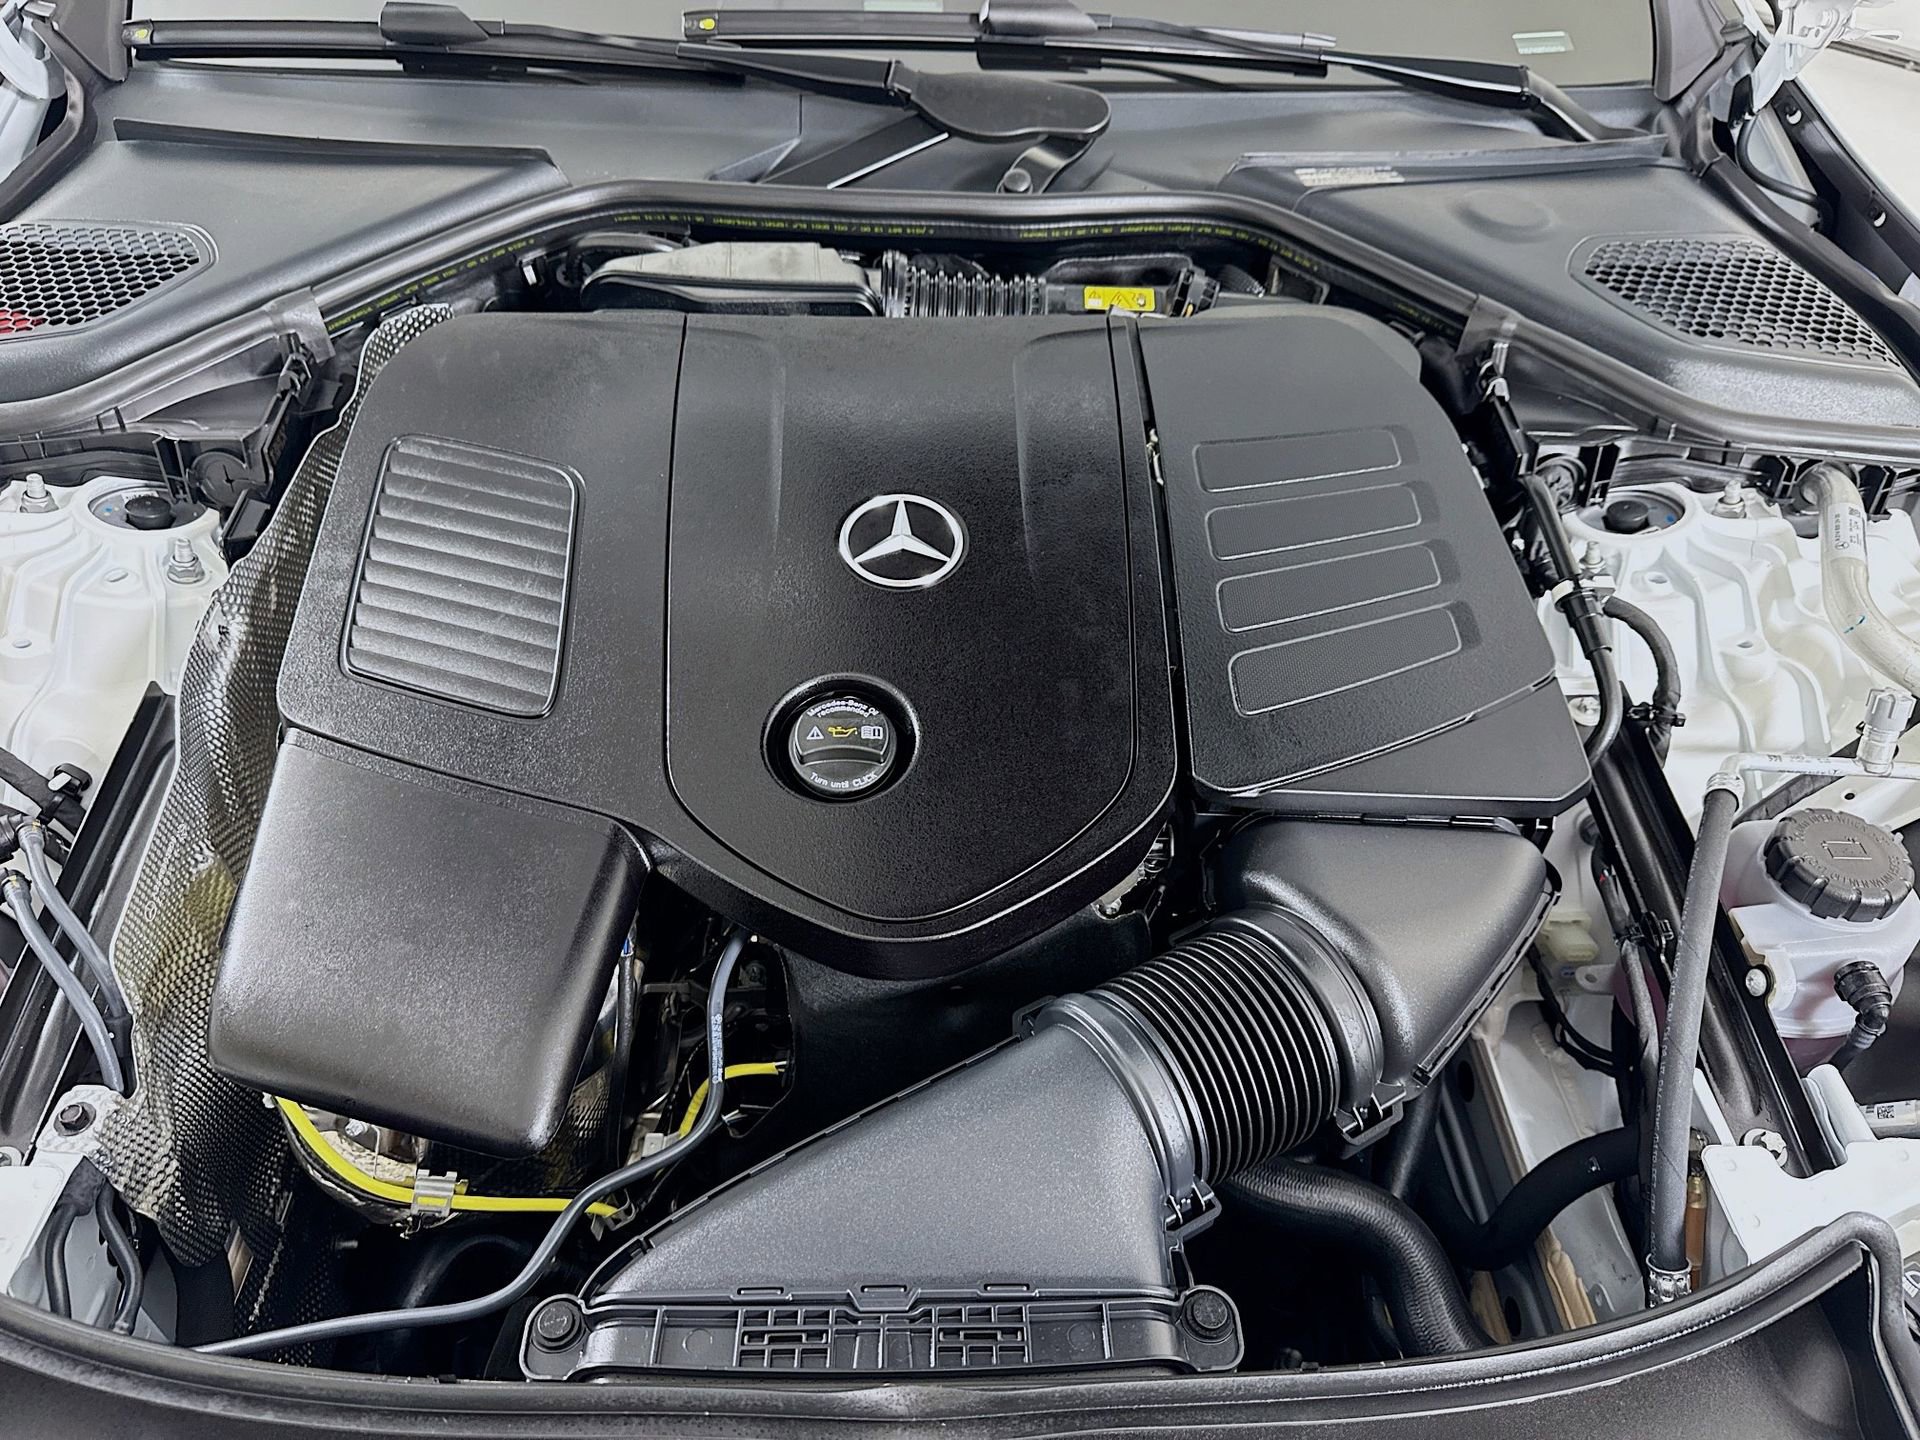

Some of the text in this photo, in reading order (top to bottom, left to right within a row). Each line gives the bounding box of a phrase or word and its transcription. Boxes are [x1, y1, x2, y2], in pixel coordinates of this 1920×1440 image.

[807, 700, 868, 716] Mercedes-Benz
[817, 706, 871, 718] recommended
[810, 770, 878, 789] Turn until CLICK
